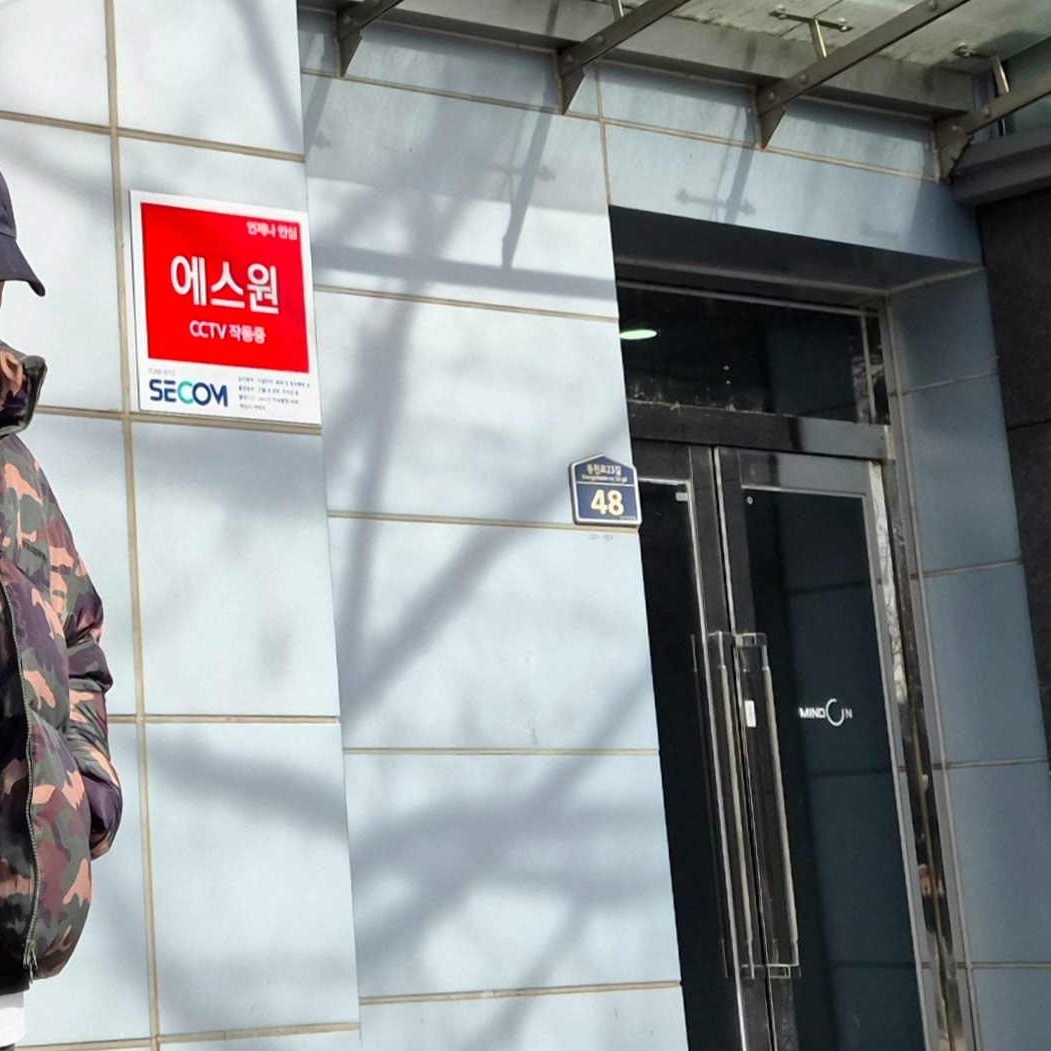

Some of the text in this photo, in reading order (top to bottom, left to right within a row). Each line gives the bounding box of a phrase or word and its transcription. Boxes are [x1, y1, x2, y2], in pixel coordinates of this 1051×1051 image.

[170, 254, 280, 315] 에스원
[189, 319, 267, 345] CCTV 작동중
[149, 378, 228, 408] SECOM
[590, 489, 625, 516] 48
